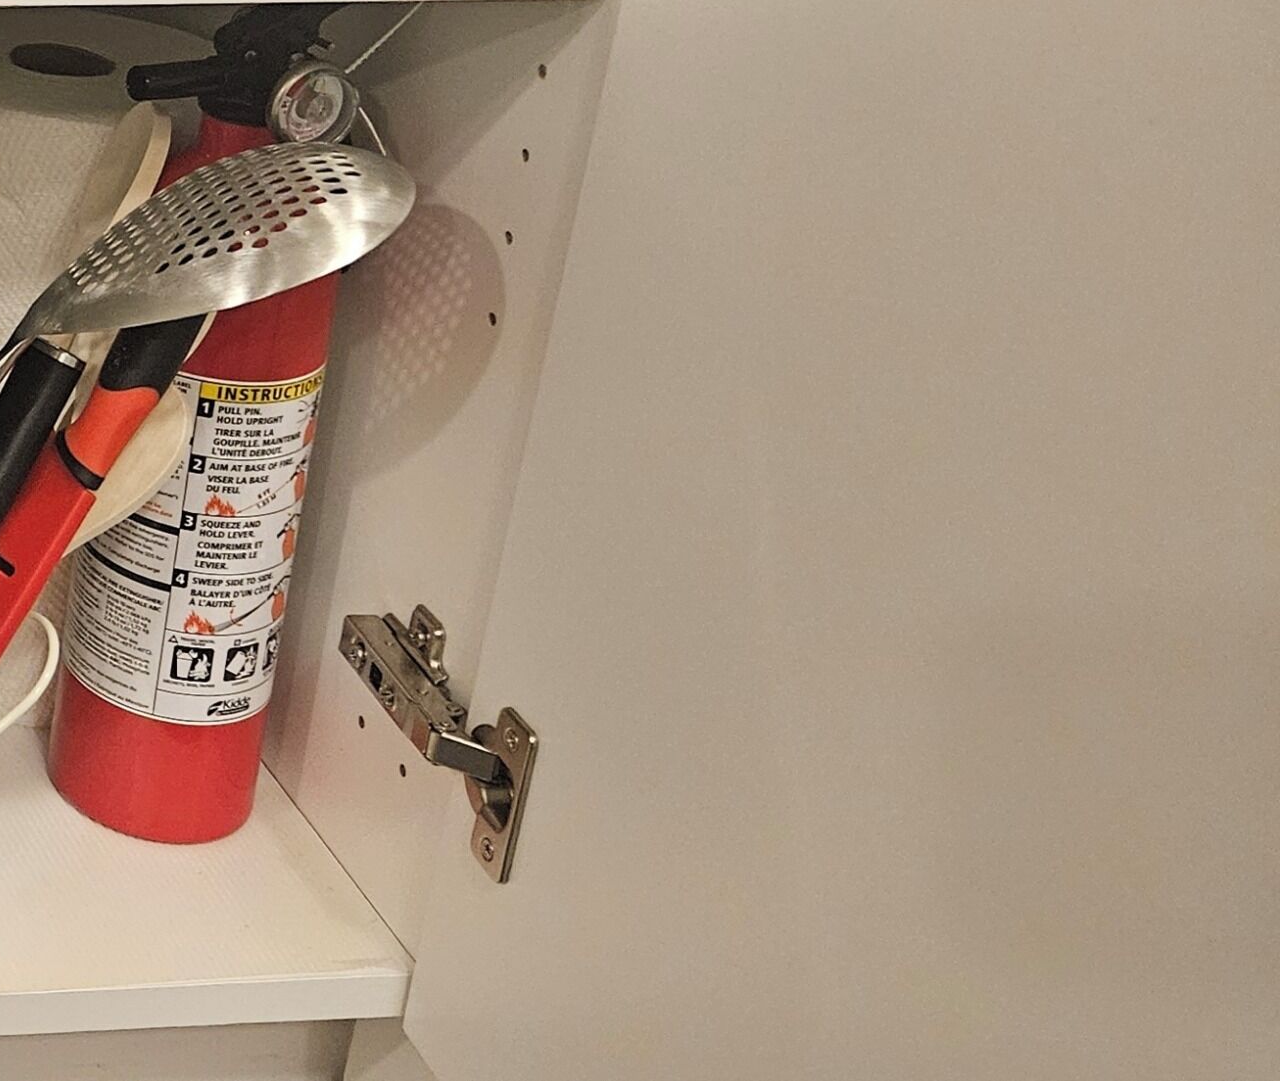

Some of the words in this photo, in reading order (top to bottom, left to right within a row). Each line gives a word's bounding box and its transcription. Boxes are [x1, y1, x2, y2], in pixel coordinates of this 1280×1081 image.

[201, 401, 210, 414] 1
[218, 405, 242, 415] PULL
[216, 415, 244, 425] HOLD
[246, 415, 284, 425] UPRIGHT
[215, 428, 242, 438] TIRER
[244, 429, 262, 438] SUR
[264, 428, 274, 437] LA
[192, 458, 203, 471] 2
[209, 462, 229, 472] AIM
[230, 463, 242, 472] AT
[244, 463, 267, 472] BASE
[268, 461, 278, 471] OF
[207, 474, 234, 484] VISER
[236, 476, 247, 484] LA
[249, 474, 269, 484] BASE
[206, 484, 220, 493] DU
[183, 515, 194, 527] 3
[200, 519, 241, 530] SQUEEZE
[243, 520, 262, 529] AND
[199, 529, 225, 539] HOLD
[197, 541, 252, 551] COMPRIMER
[254, 540, 264, 549] ET
[196, 550, 246, 560] MAINTENIR
[248, 551, 258, 559] LE
[175, 573, 186, 585] 4
[192, 576, 224, 586] SWEEP
[225, 577, 244, 587] SIDE
[246, 576, 257, 585] TO
[190, 589, 231, 599] BALAYER
